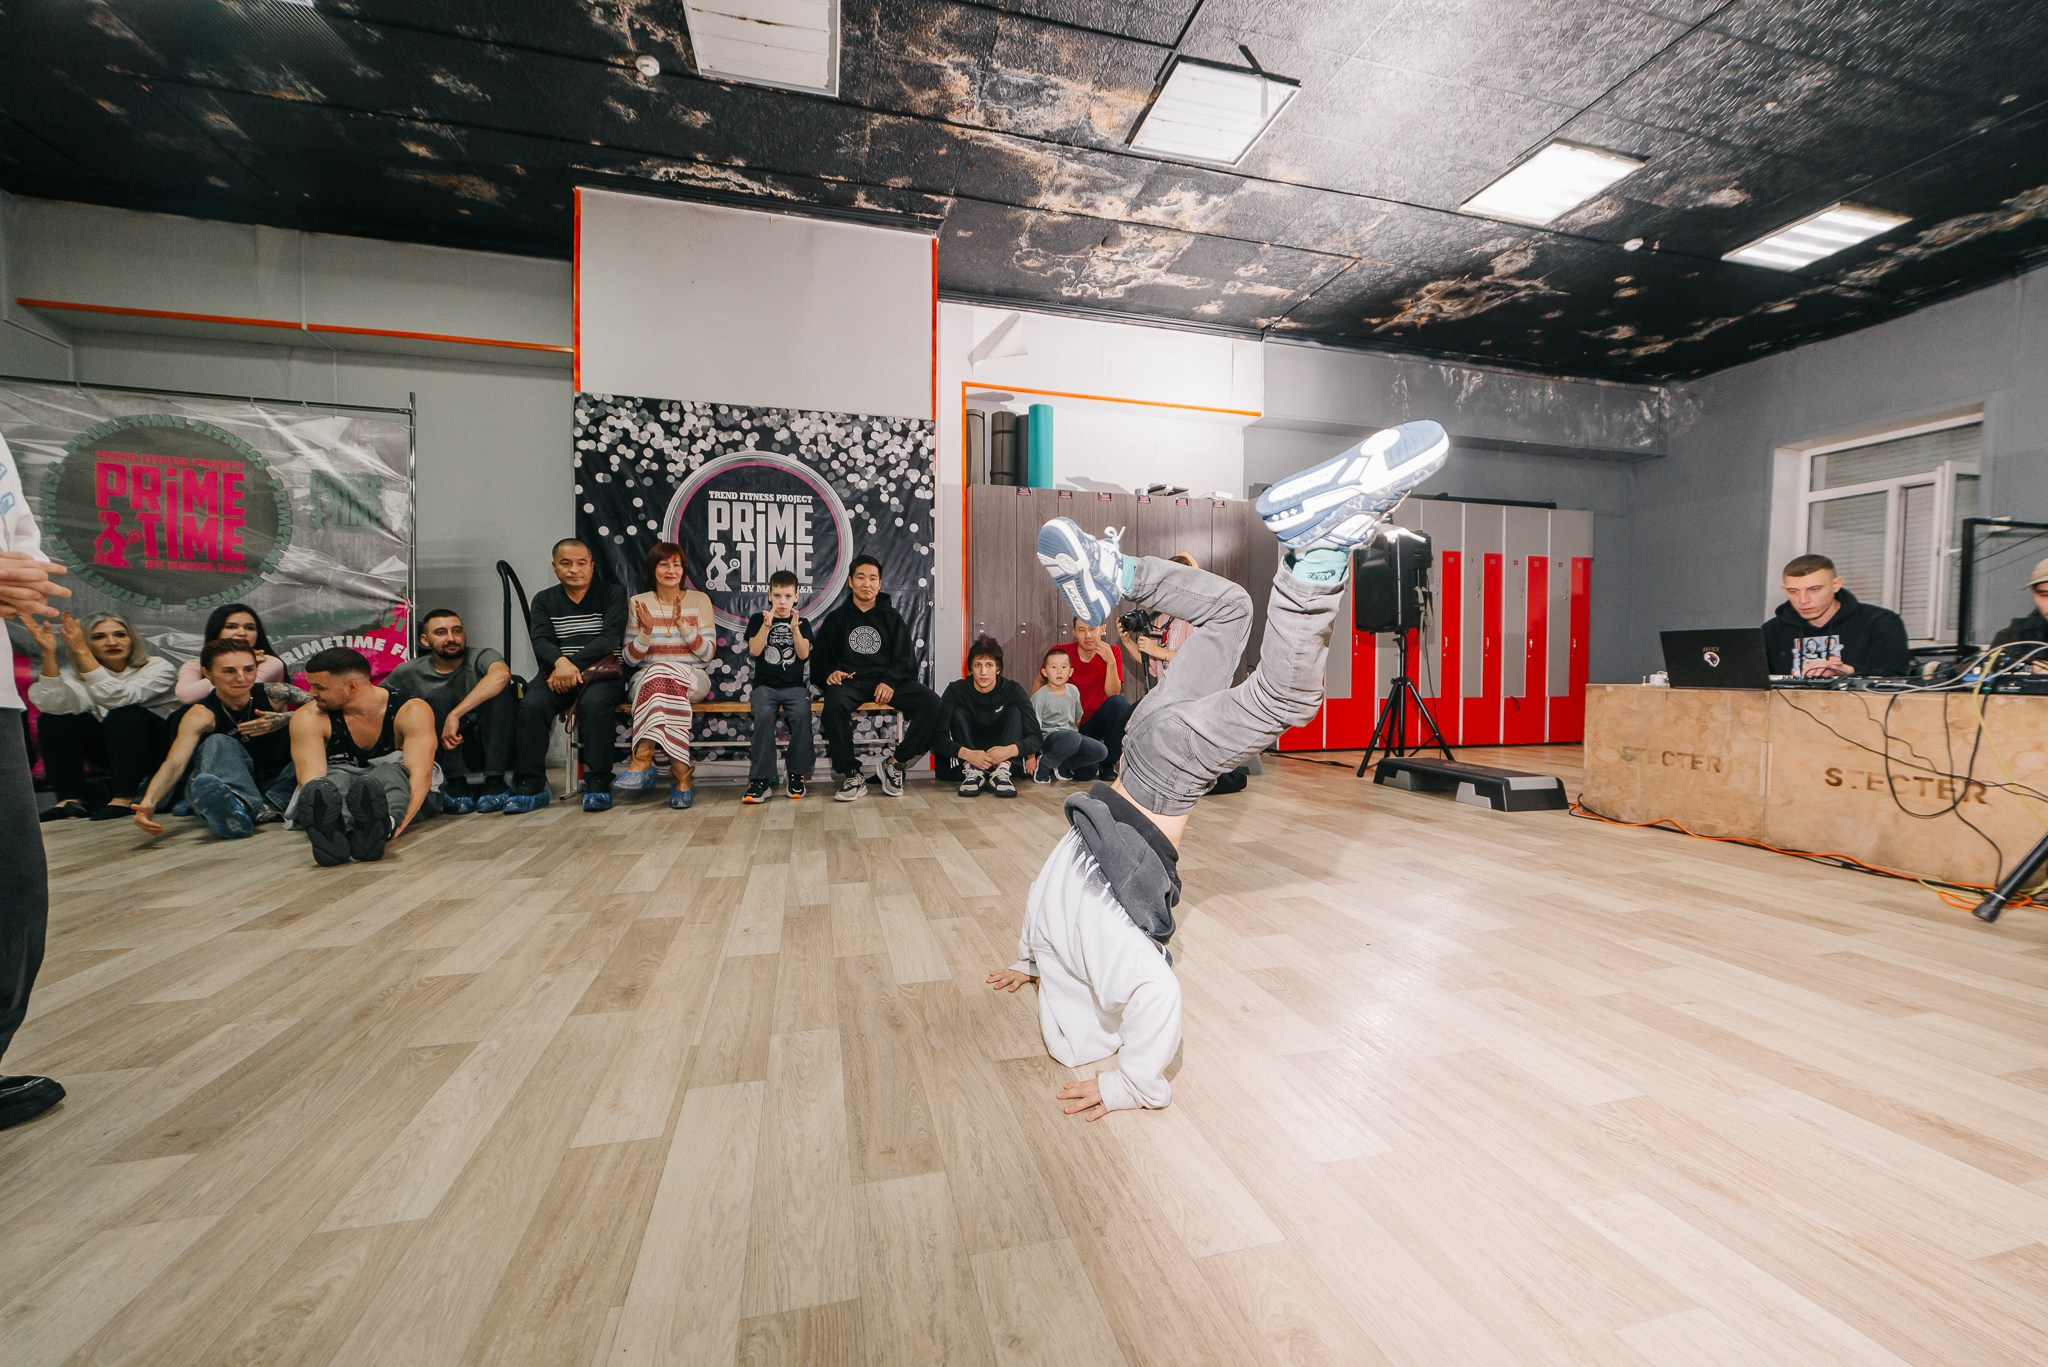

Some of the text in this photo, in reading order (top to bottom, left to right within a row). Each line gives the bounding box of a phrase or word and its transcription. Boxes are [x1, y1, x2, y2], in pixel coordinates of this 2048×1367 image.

[63, 414, 271, 470] PRIMETIME FITNESS
[708, 490, 813, 504] TREND FITNESS PROJECT
[135, 511, 246, 561] TIME
[735, 542, 814, 584] TIME
[741, 584, 755, 593] BY
[279, 635, 386, 665] RIMETIME
